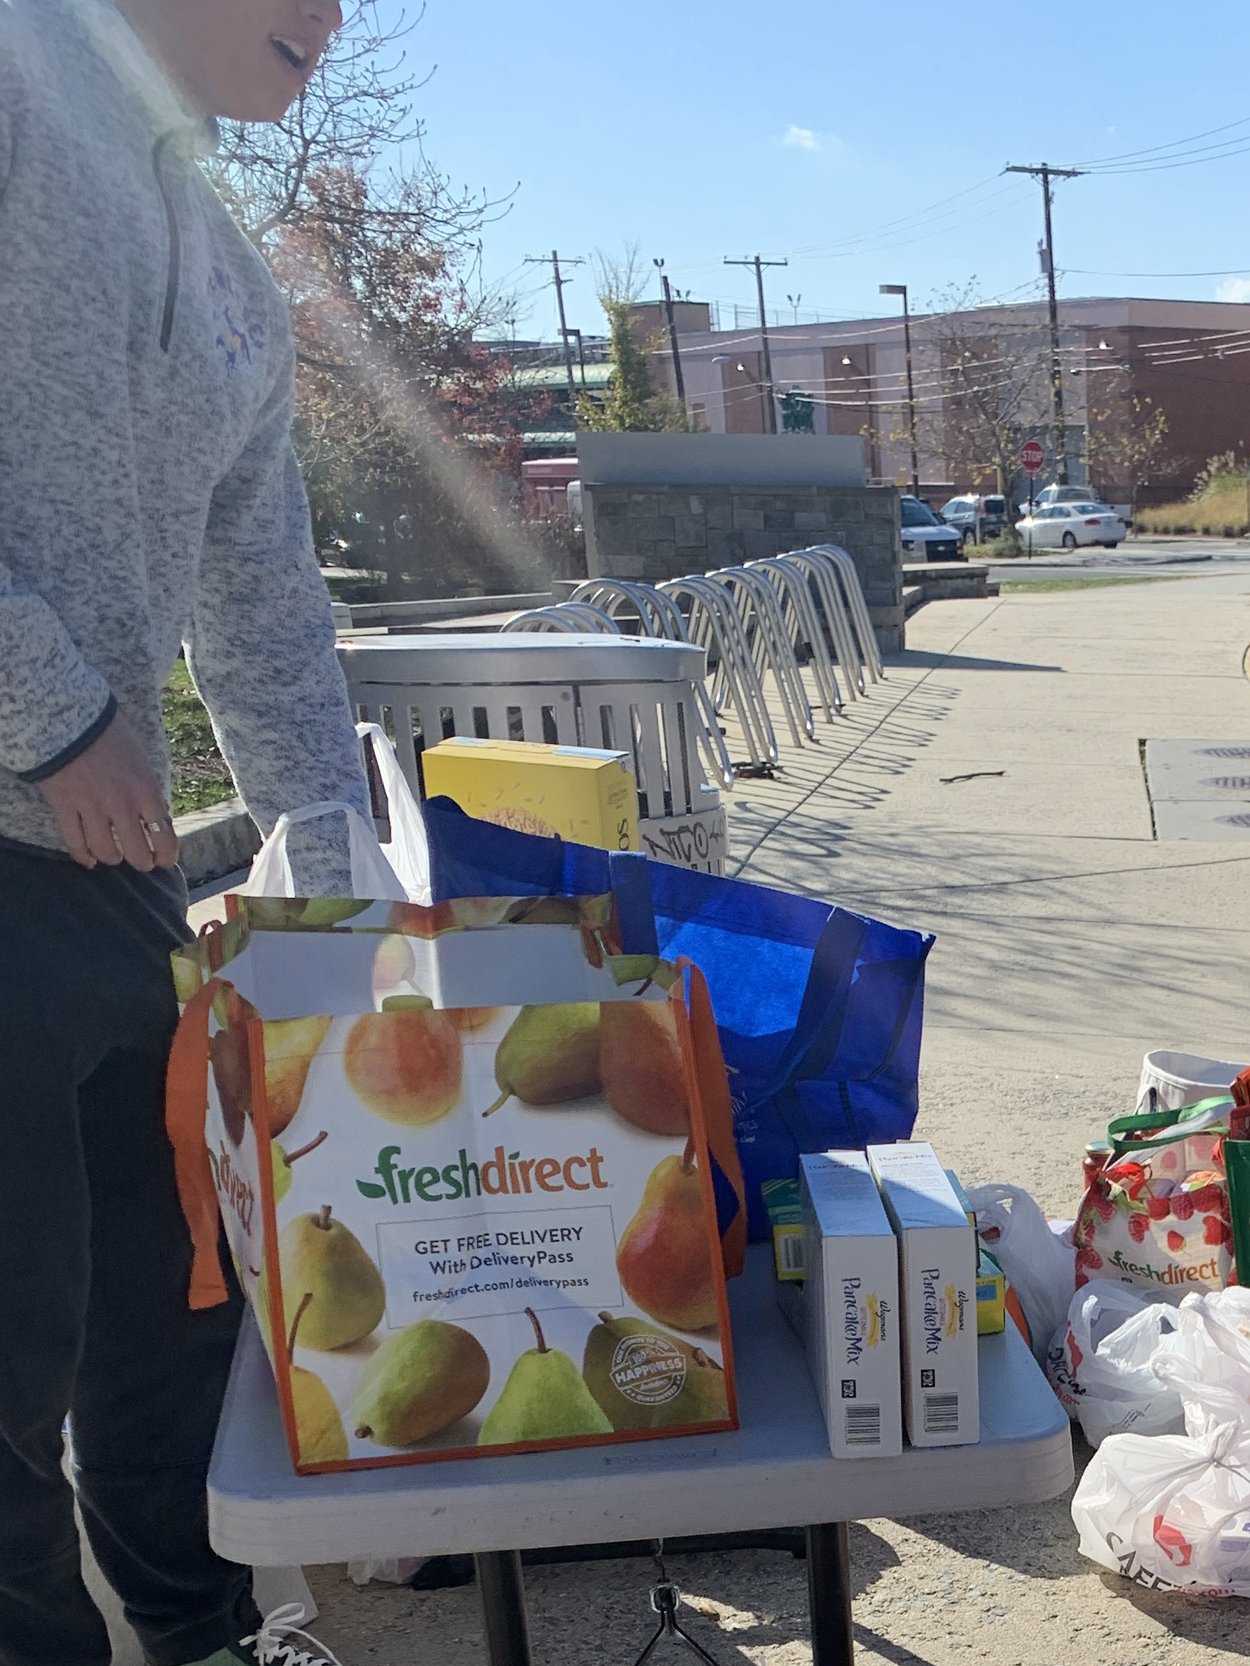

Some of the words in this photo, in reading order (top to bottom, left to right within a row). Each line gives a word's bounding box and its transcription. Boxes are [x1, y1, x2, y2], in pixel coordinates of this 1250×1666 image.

[1022, 450, 1044, 462] STOP
[372, 1145, 609, 1205] freshdirect
[415, 1239, 450, 1254] GET
[457, 1233, 492, 1251] FREE
[496, 1227, 584, 1246] DELIVERY
[428, 1259, 466, 1275] With
[470, 1251, 574, 1270] DeliveryPass
[1110, 1250, 1219, 1286] freshdirect
[412, 1276, 589, 1302] freshdirect.com/deliverypass
[615, 1358, 683, 1384] HAPPINESS
